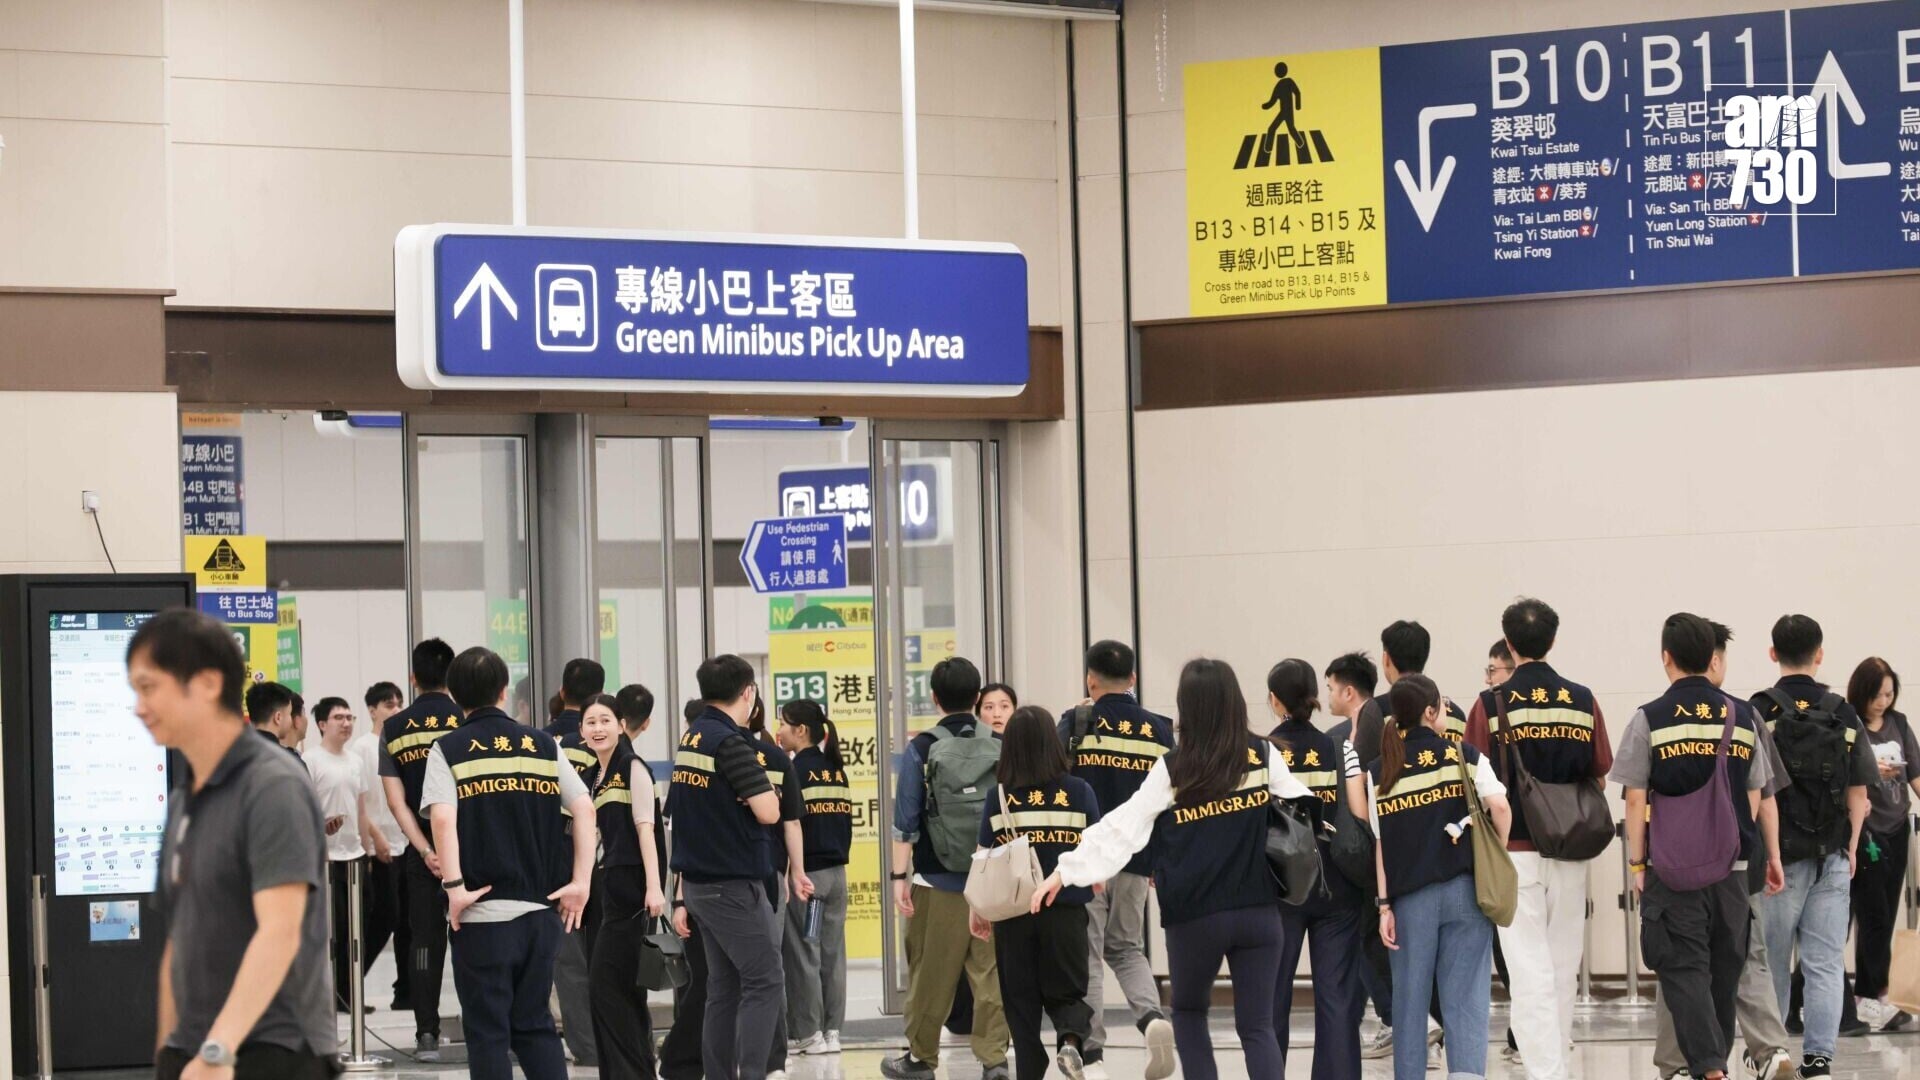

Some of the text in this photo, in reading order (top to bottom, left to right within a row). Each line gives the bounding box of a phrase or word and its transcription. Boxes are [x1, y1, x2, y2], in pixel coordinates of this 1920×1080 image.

[1642, 27, 1754, 97] B11
[1490, 40, 1611, 110] B10
[1491, 113, 1556, 143] 葵翠邨
[1642, 134, 1660, 146] Tin
[1663, 133, 1678, 145] Fu
[1680, 132, 1701, 143] Bus
[1899, 139, 1919, 151] Wu
[1491, 142, 1580, 159] Kwai Tsui Estate
[1246, 179, 1323, 208] 過馬路往
[1645, 203, 1666, 215] Via:
[1670, 202, 1690, 213] San
[1693, 200, 1711, 212] Tin
[1494, 215, 1514, 227] Via:
[1517, 212, 1534, 224] Tai
[1536, 212, 1561, 223] Lam
[1645, 216, 1748, 232] Yuen Long Station
[1494, 227, 1579, 244] Tsing Yi Station
[1646, 233, 1714, 249] Tin Shui Wai
[1218, 240, 1355, 272] 專線小巴上客點
[1494, 246, 1552, 260] Kwai Fong
[1204, 281, 1231, 293] Cross
[1235, 280, 1249, 290] the
[1252, 278, 1272, 289] road
[1275, 279, 1285, 288] to
[1340, 272, 1360, 283] B15
[1363, 271, 1370, 281] &
[615, 265, 856, 318] 專線小巴上客區
[1220, 285, 1356, 304] Green Minibus Pick Up Points
[616, 321, 964, 367] Green Minibus Pick Up Area
[767, 521, 830, 535] Use Pedestrian
[781, 535, 817, 546] Crossing
[781, 549, 816, 566] 請使用
[769, 568, 829, 587] 行人過路處
[228, 610, 235, 618] to
[238, 610, 253, 618] Bus
[255, 610, 274, 619] Stop
[776, 676, 825, 700] B13
[1509, 688, 1573, 703] 入境處
[833, 706, 872, 715] Hong Kong
[406, 714, 459, 729] 入境處
[1097, 717, 1154, 738] 入境處
[469, 734, 537, 753] 入境處
[1077, 753, 1153, 772] IMMIGRATI
[808, 769, 844, 783] 入境處
[1007, 788, 1070, 807] 入境處
[1377, 783, 1464, 816] IMMIGRATI
